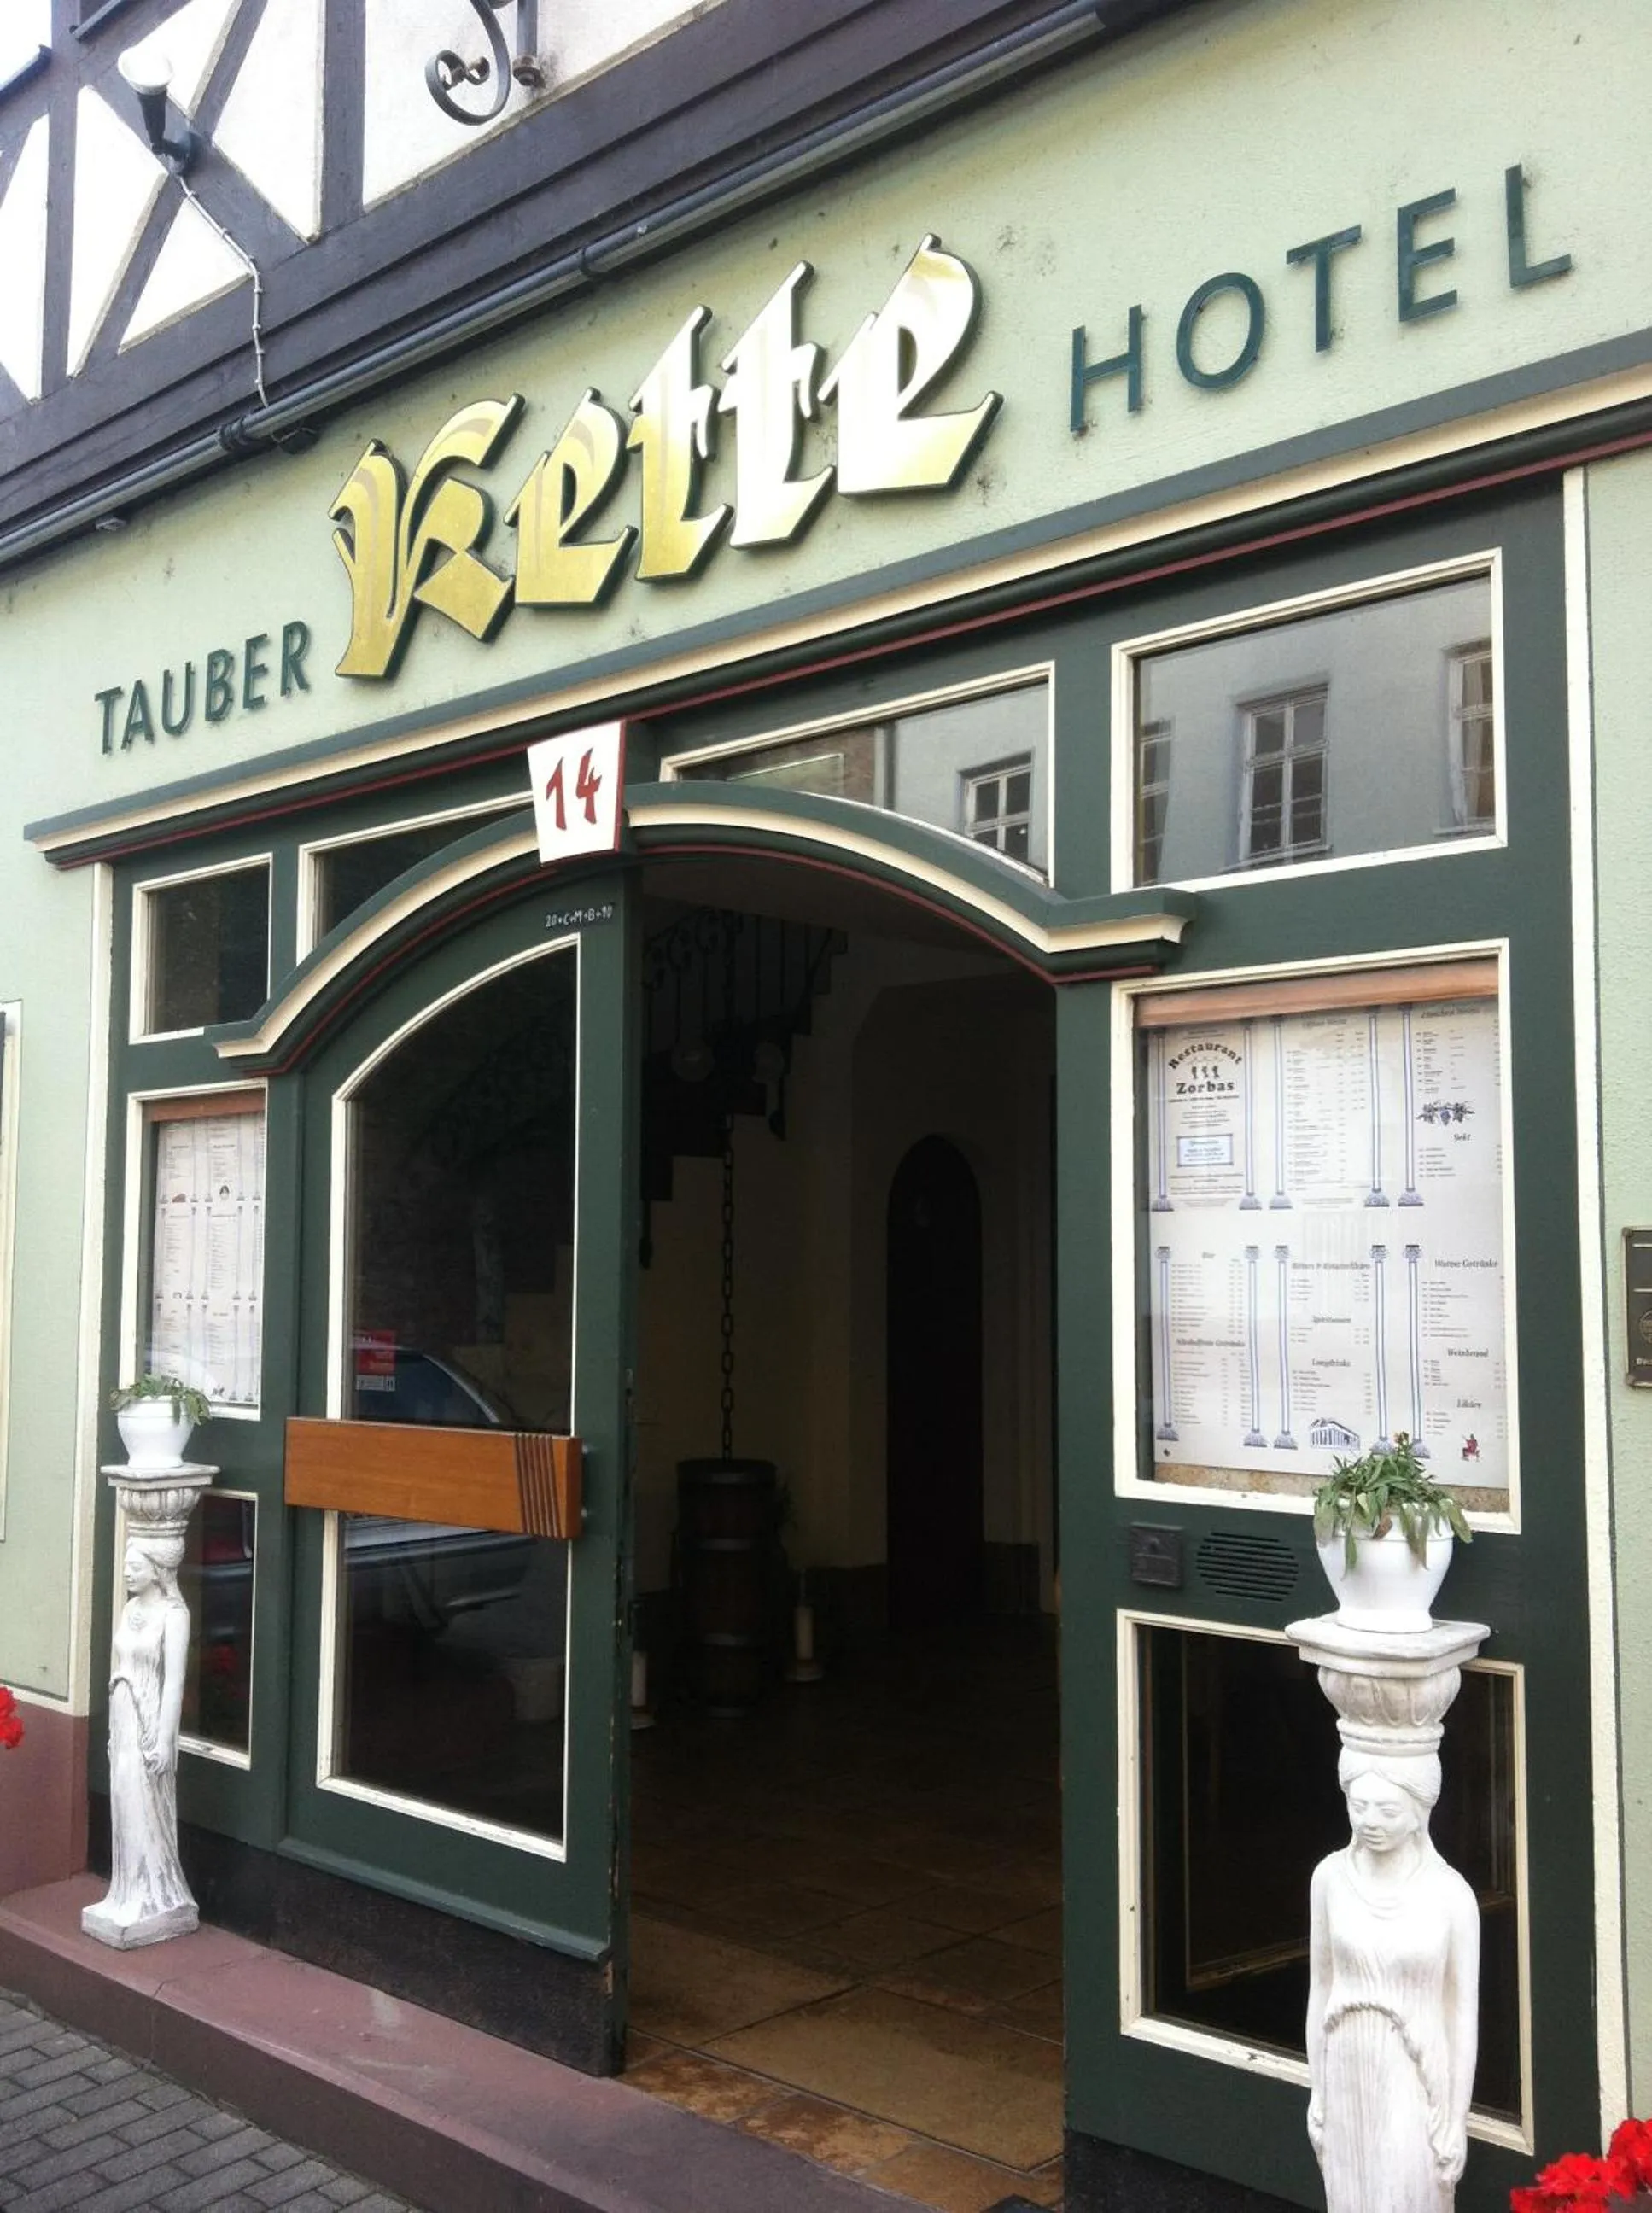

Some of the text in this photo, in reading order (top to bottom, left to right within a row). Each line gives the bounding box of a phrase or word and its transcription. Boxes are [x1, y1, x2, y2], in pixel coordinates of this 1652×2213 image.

[94, 163, 1572, 755] TAUBER Kette HOTEL
[546, 746, 602, 831] 14
[1168, 1042, 1243, 1069] Restaurant
[1176, 1080, 1235, 1095] Zorbas
